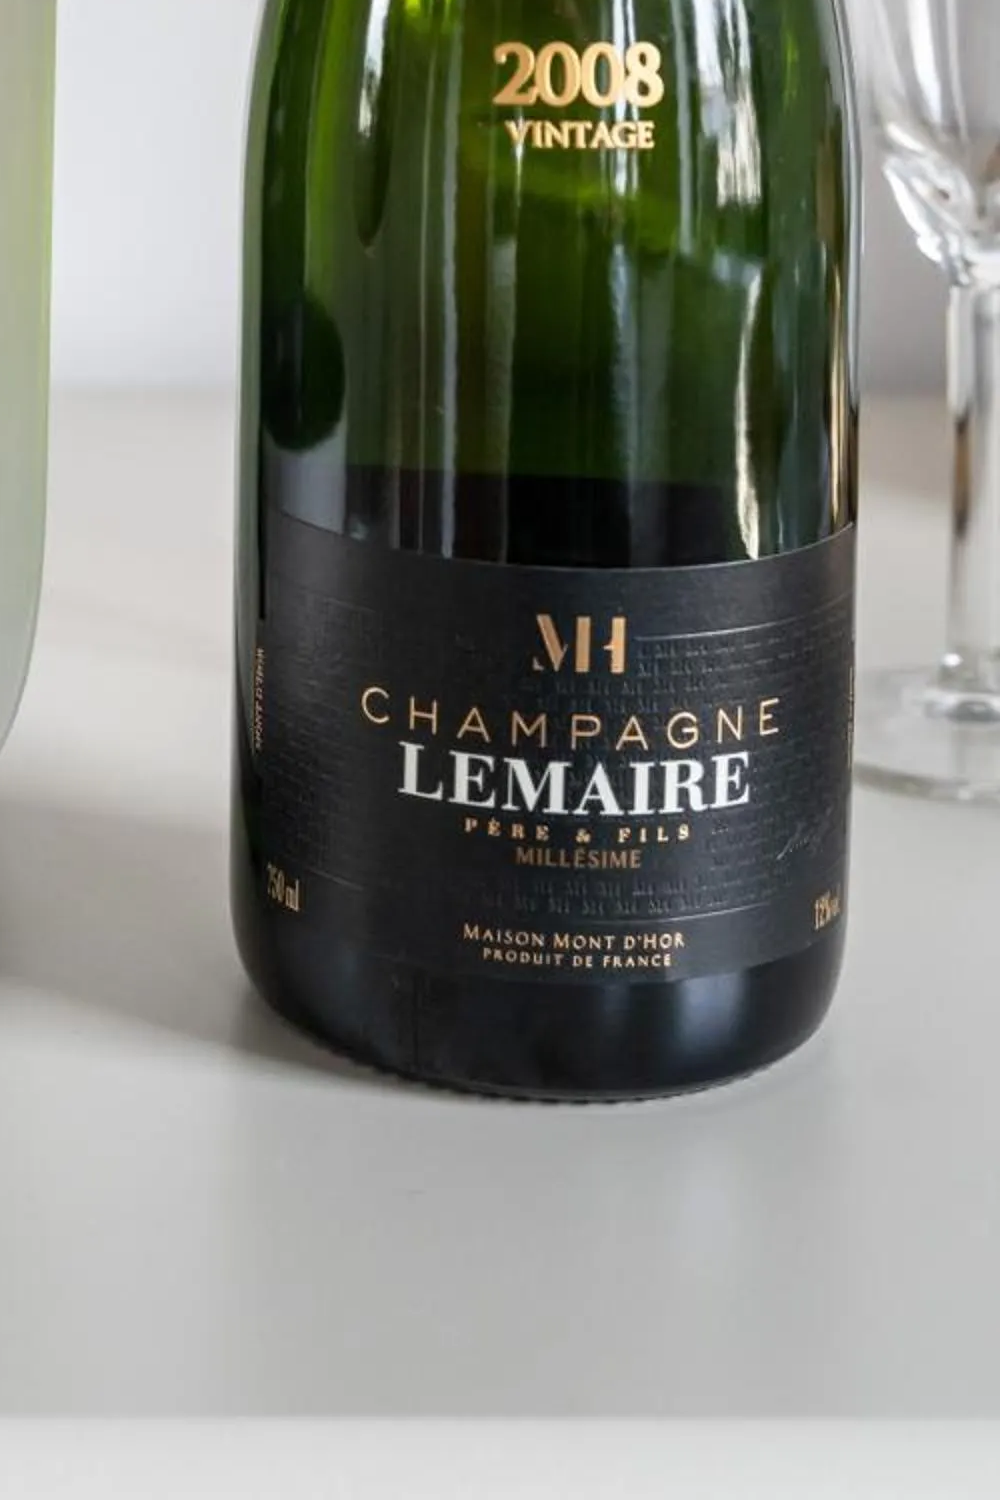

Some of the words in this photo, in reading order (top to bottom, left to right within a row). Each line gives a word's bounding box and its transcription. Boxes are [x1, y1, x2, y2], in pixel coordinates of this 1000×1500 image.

[492, 41, 665, 108] 2008
[504, 120, 656, 149] VINTAGE
[361, 686, 781, 751] CHAMPAGNE
[398, 741, 750, 817] LEMAIRE
[463, 816, 550, 842] PÈRE
[575, 828, 592, 844] &
[617, 823, 691, 844] FILS
[514, 845, 643, 869] MILLÉSIME
[463, 923, 545, 947] MAISON
[553, 932, 616, 950] MONT
[623, 931, 685, 950] D'HOR
[482, 947, 564, 966] PRODUIT
[572, 955, 593, 968] DE
[602, 953, 672, 968] FRANCE
